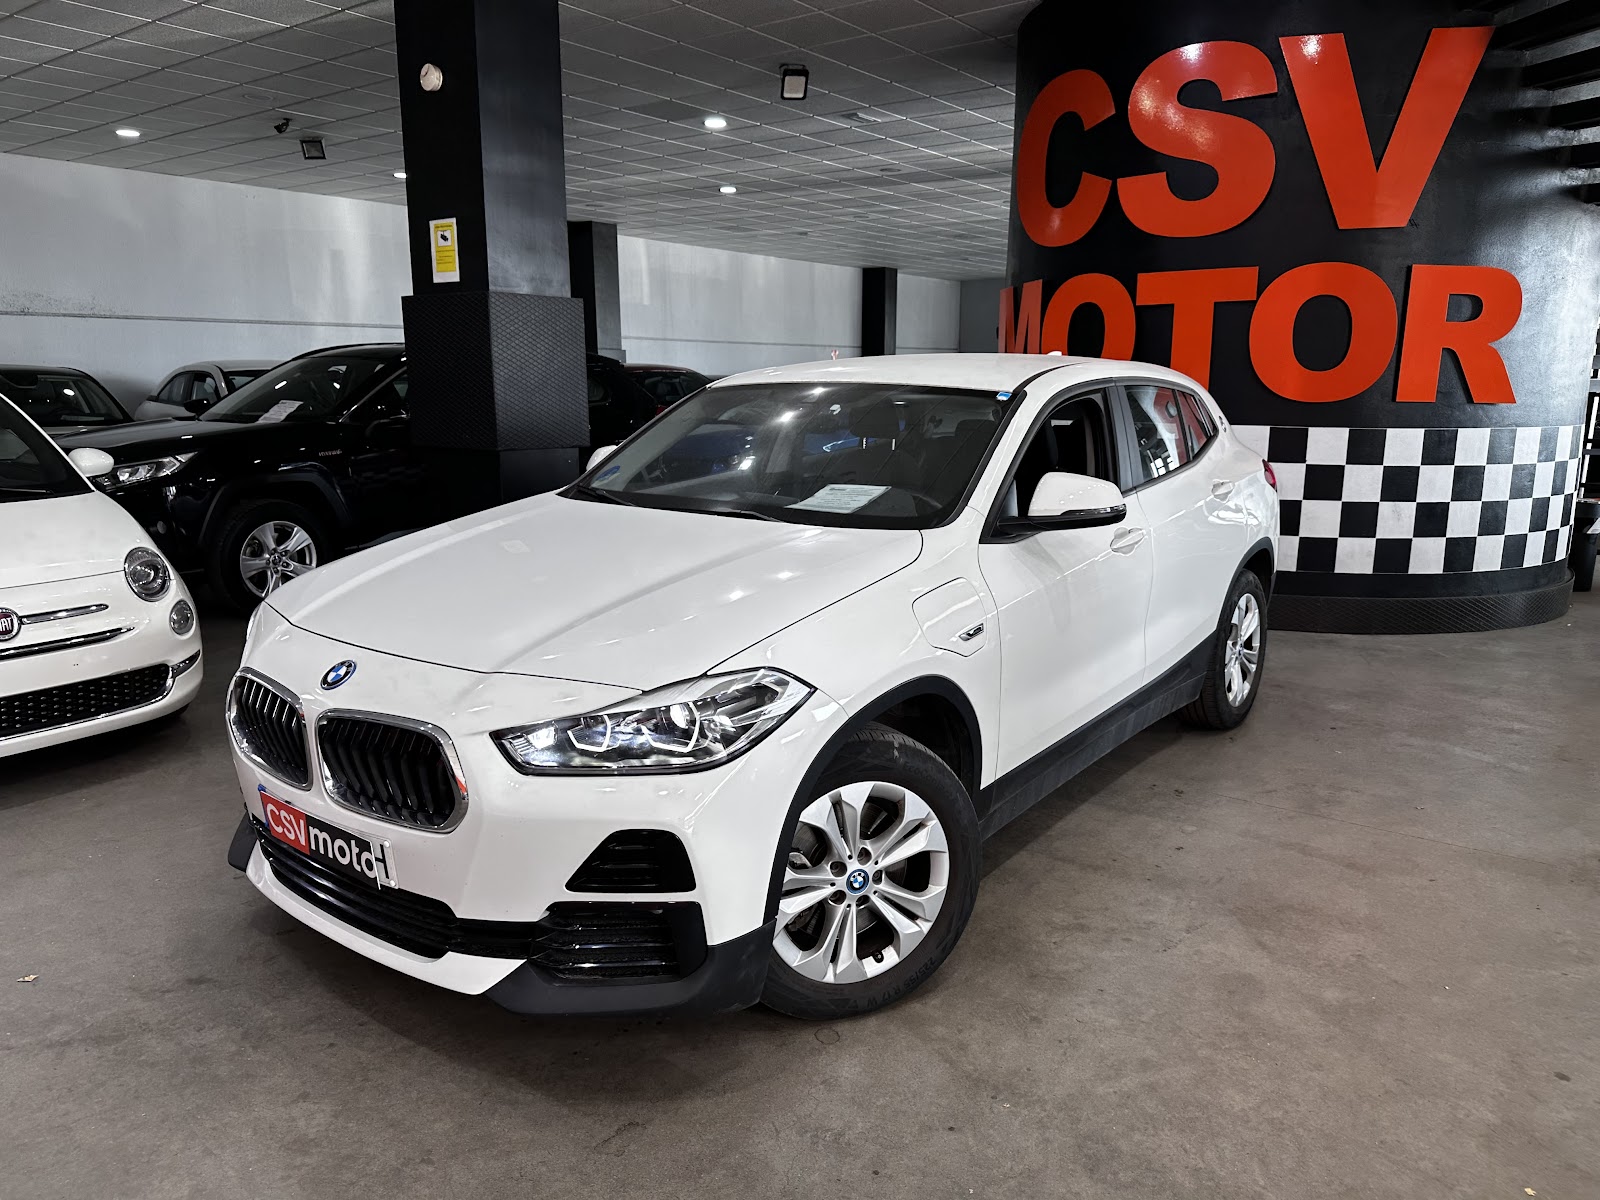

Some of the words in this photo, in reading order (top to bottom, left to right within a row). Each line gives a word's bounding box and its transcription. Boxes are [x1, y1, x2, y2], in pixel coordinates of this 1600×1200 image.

[1017, 26, 1496, 247] CSV
[998, 262, 1523, 403] MOTOR
[266, 803, 306, 846] CSV
